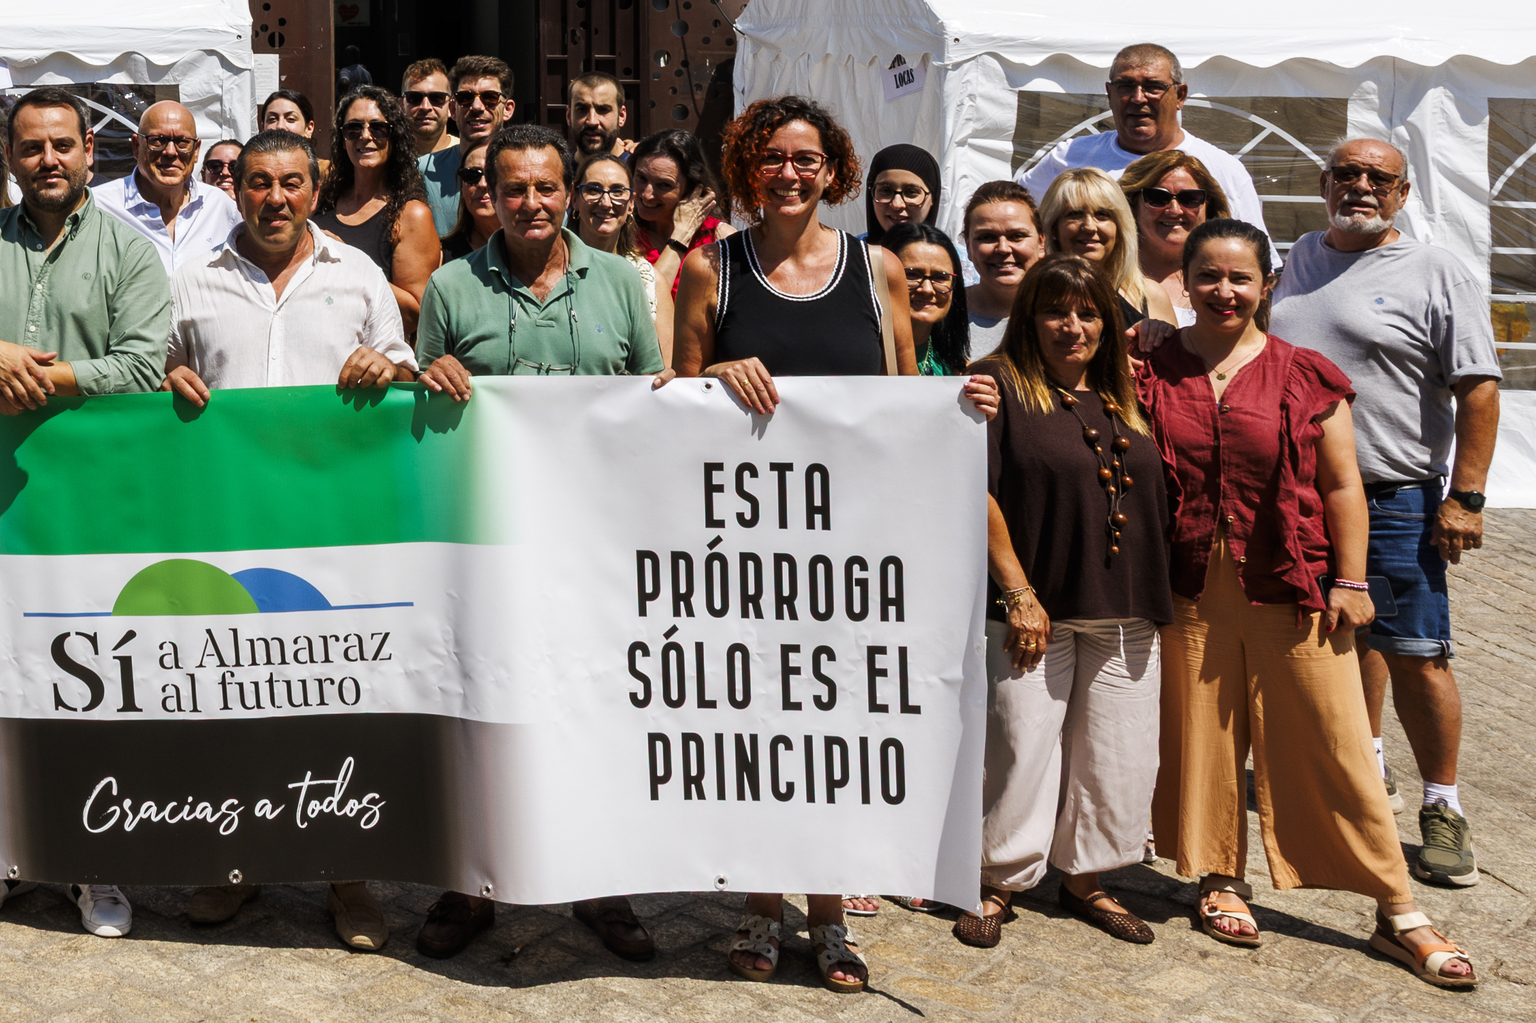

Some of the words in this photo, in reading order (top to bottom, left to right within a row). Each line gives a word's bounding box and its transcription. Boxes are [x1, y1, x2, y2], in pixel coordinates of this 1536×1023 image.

[894, 68, 915, 89] LOCAS
[703, 462, 832, 531] ESTA
[635, 534, 906, 623] PRÓRROGA
[50, 629, 143, 713] Sí
[158, 640, 183, 670] a
[195, 627, 393, 669] Almaraz
[161, 672, 202, 714] al
[218, 669, 361, 711] futuro
[627, 624, 752, 710] SÓLO
[780, 643, 837, 712] ES
[866, 645, 922, 715] EL
[82, 776, 244, 835] Gracias
[254, 796, 286, 821] a
[287, 756, 387, 830] todos
[647, 732, 906, 806] PRINCIPIO
